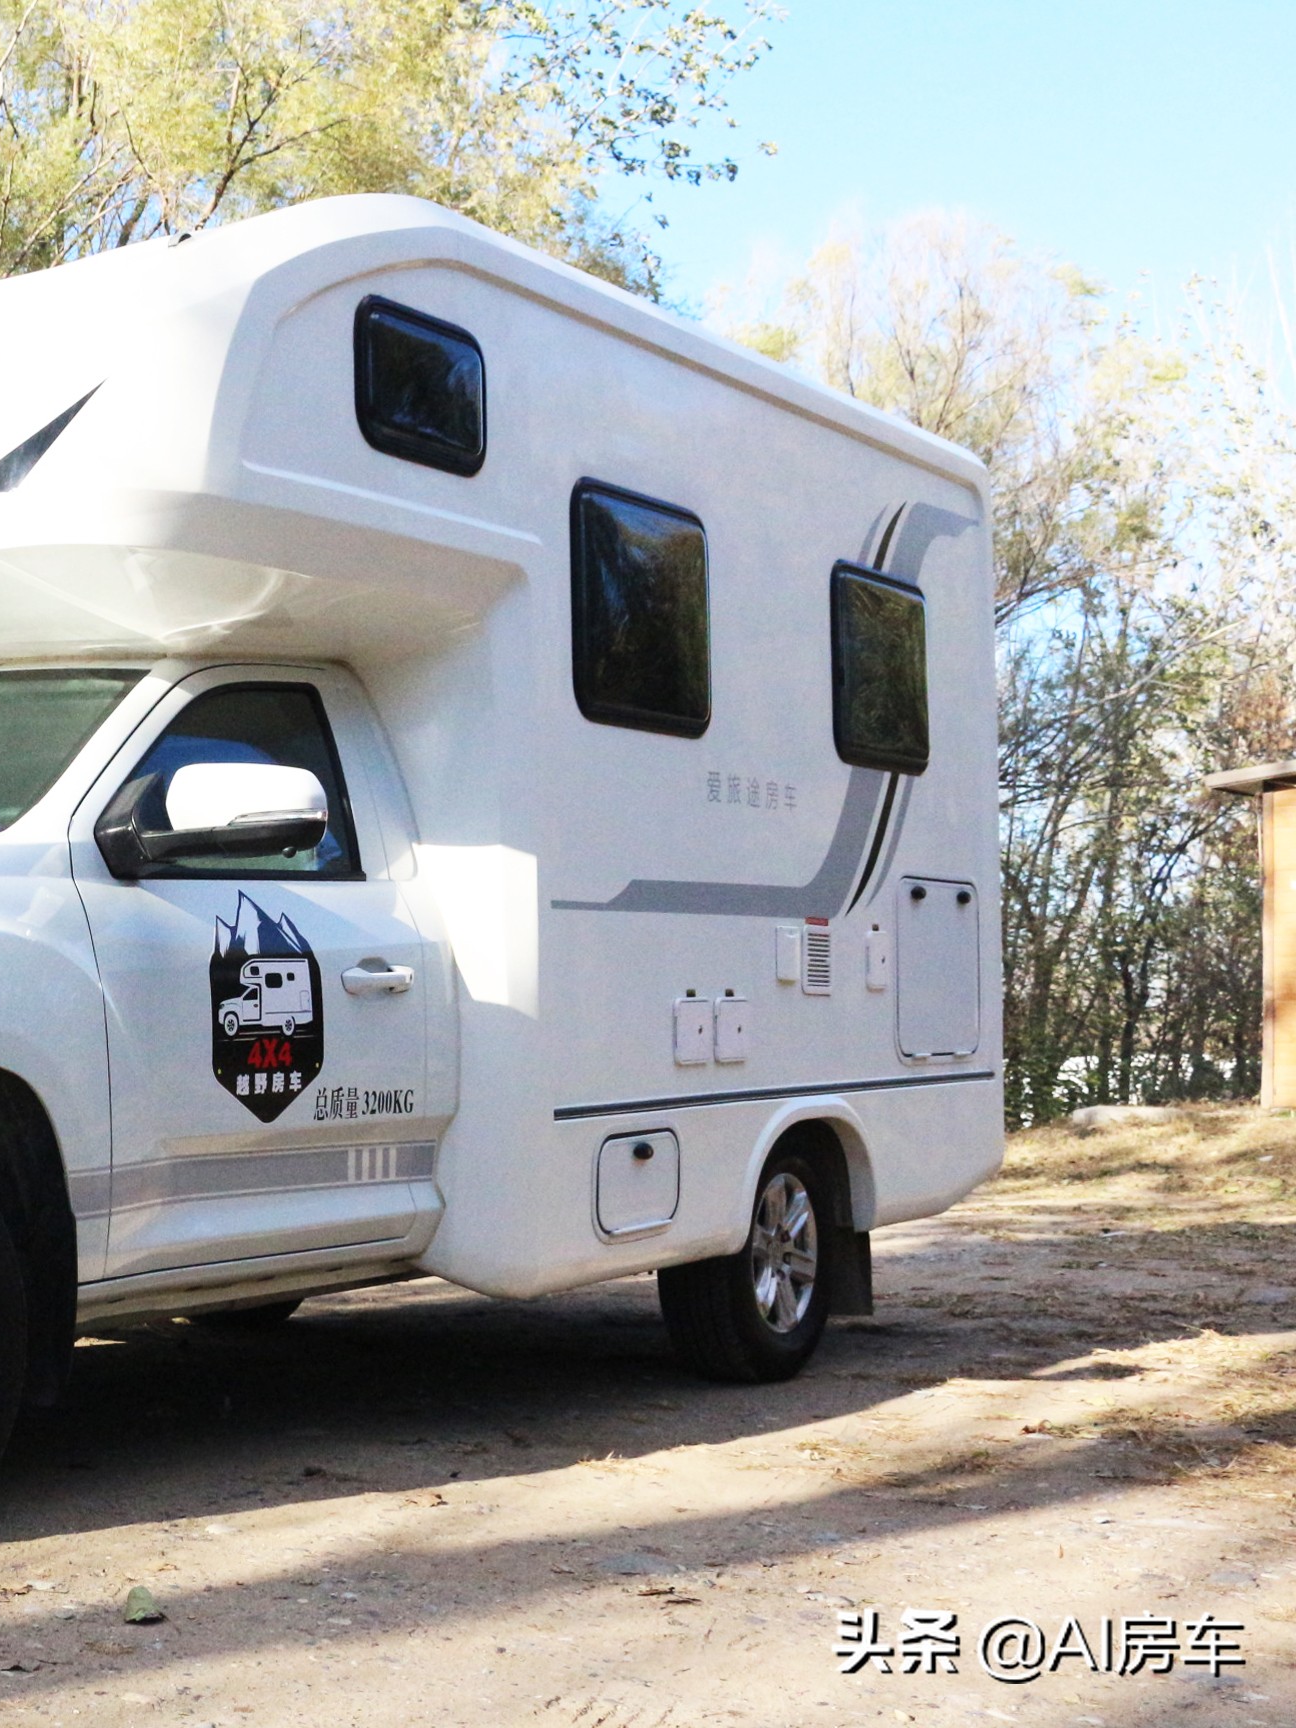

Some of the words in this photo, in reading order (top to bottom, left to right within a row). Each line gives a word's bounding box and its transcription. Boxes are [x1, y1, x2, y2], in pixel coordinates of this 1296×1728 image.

[247, 1038, 292, 1069] 4X4
[236, 1070, 302, 1096] 越野房车
[313, 1086, 359, 1121] 总质量
[361, 1089, 414, 1116] 3200KG
